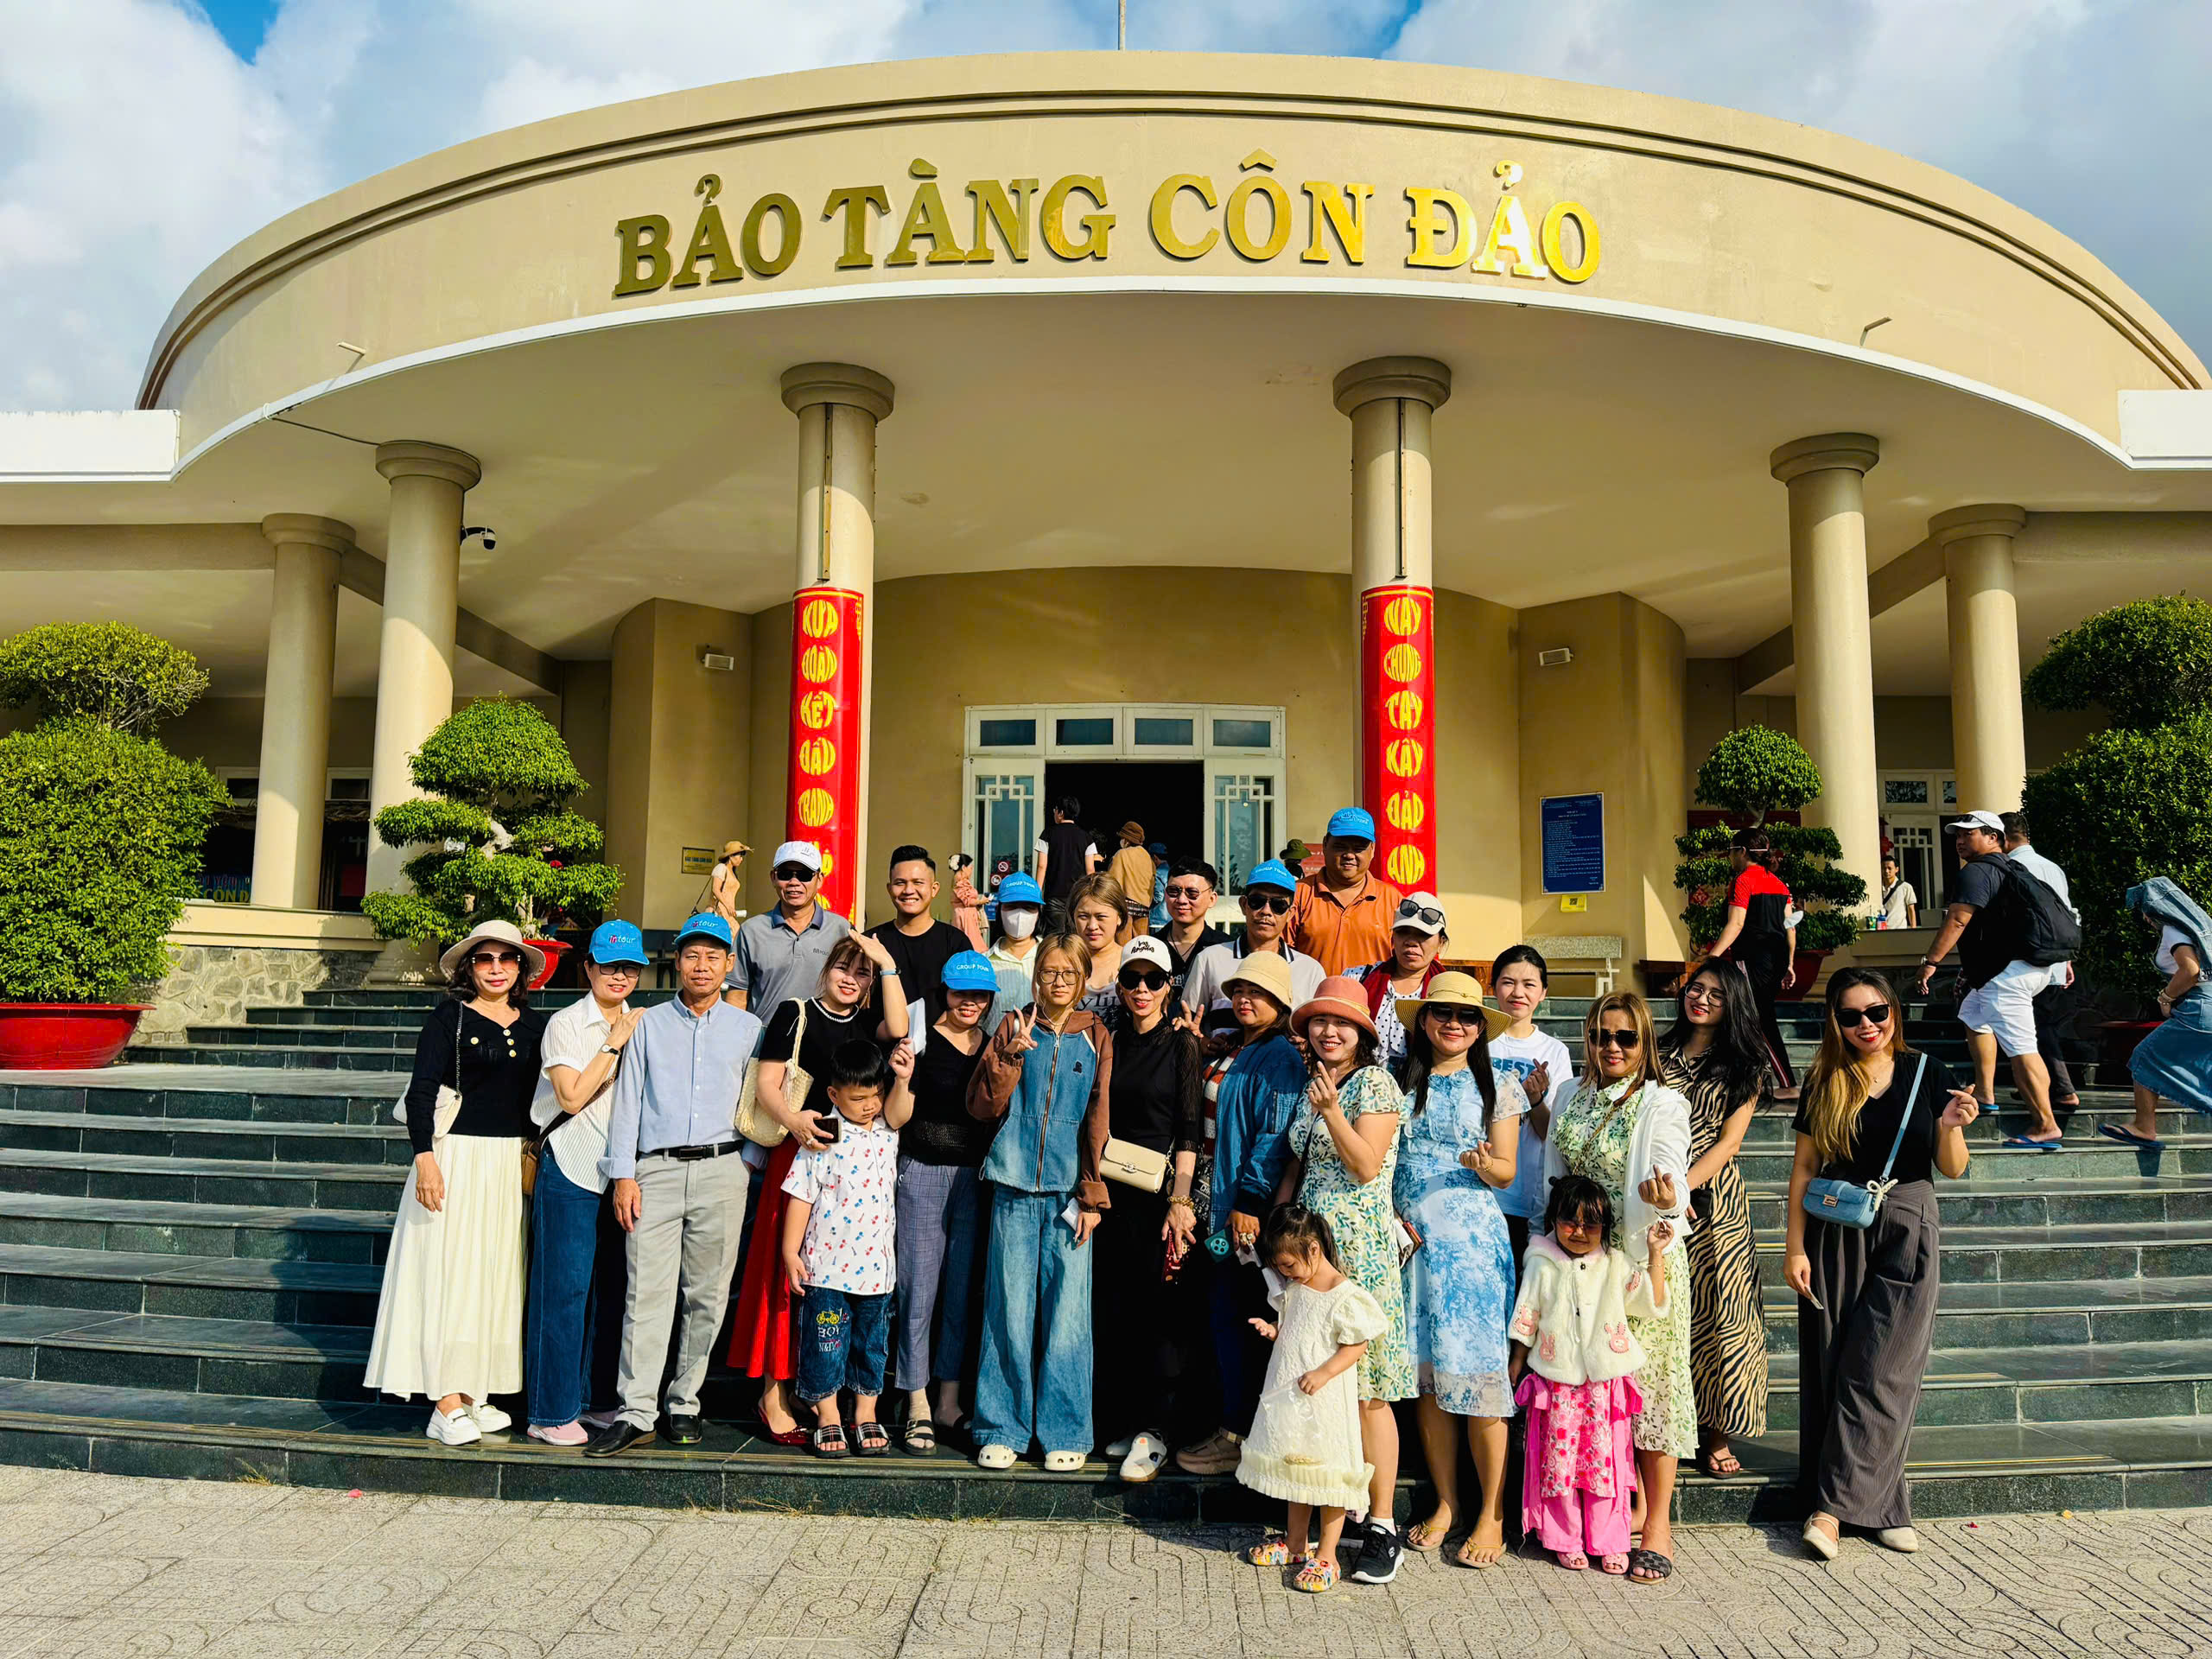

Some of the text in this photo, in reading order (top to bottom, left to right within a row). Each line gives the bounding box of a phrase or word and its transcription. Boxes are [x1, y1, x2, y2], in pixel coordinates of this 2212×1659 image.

[613, 148, 1601, 296] BẢO TÀNG CÔN ĐẢO
[1384, 597, 1421, 636] NAY
[801, 645, 838, 683] ĐOÀN
[1383, 643, 1422, 683] CHUNG
[800, 690, 838, 729] KẾT
[1385, 690, 1423, 730] TAY
[799, 737, 836, 776] ĐẤU
[798, 787, 835, 827] TRANH
[1385, 790, 1425, 830] ĐẢO
[1387, 843, 1425, 885] ANH
